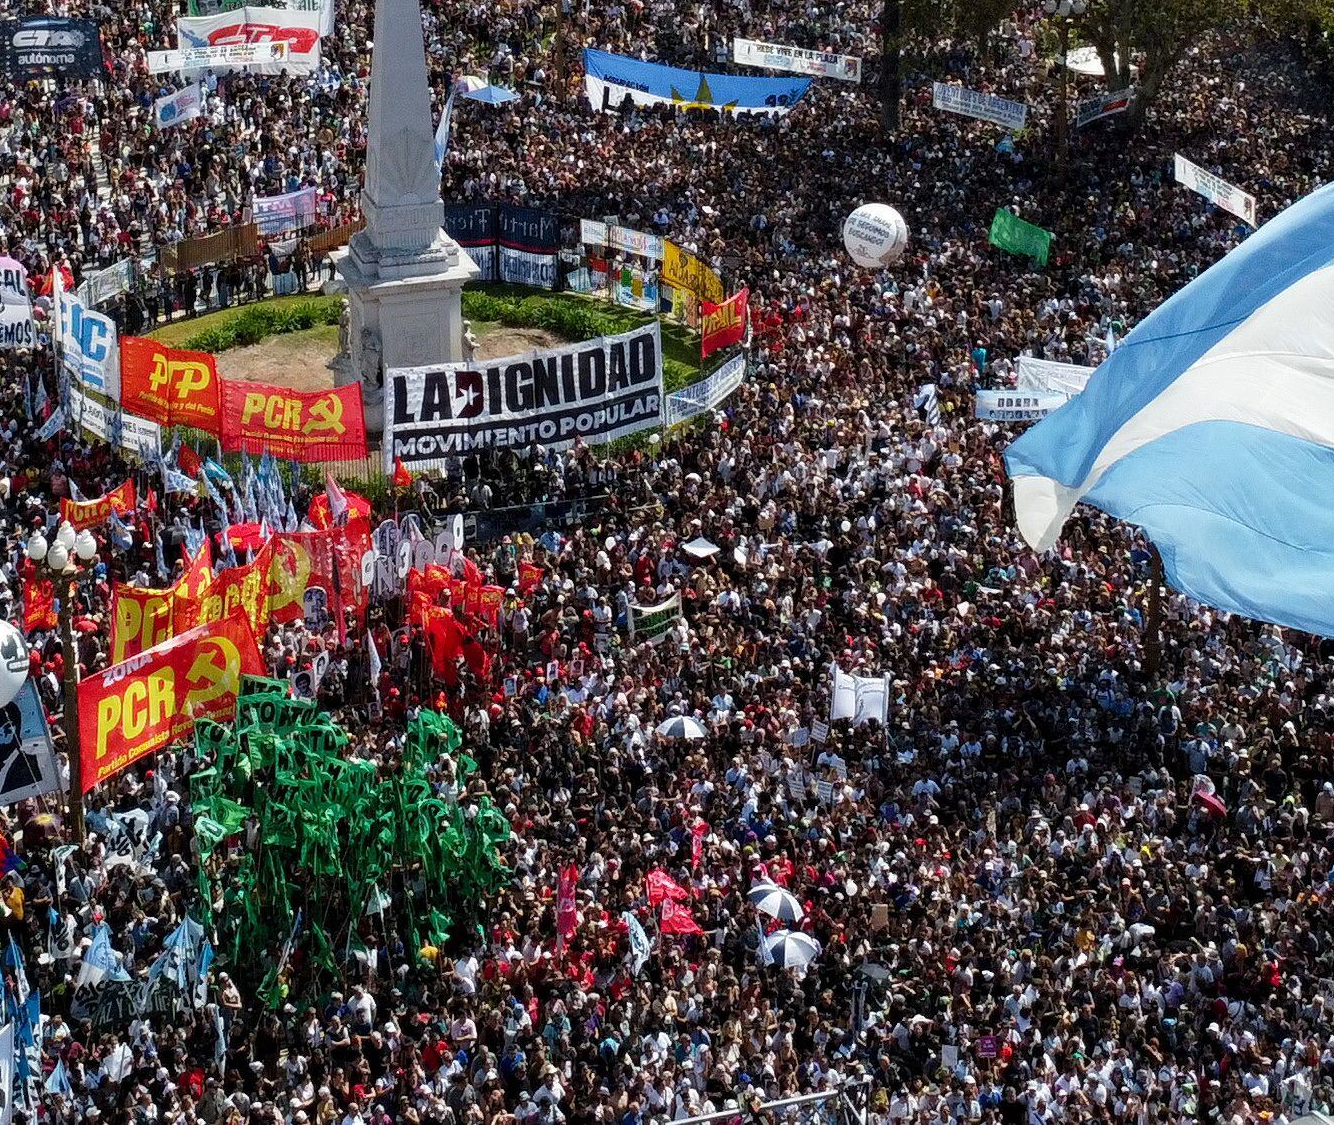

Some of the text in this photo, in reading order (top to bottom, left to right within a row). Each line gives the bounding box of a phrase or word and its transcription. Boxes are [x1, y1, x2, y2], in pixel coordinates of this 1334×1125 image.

[241, 392, 303, 431] PCR
[394, 394, 660, 458] MOVIMIENTO POPULAR
[101, 654, 154, 688] ZONA
[95, 665, 177, 761] PCR
[97, 753, 128, 778] Partido
